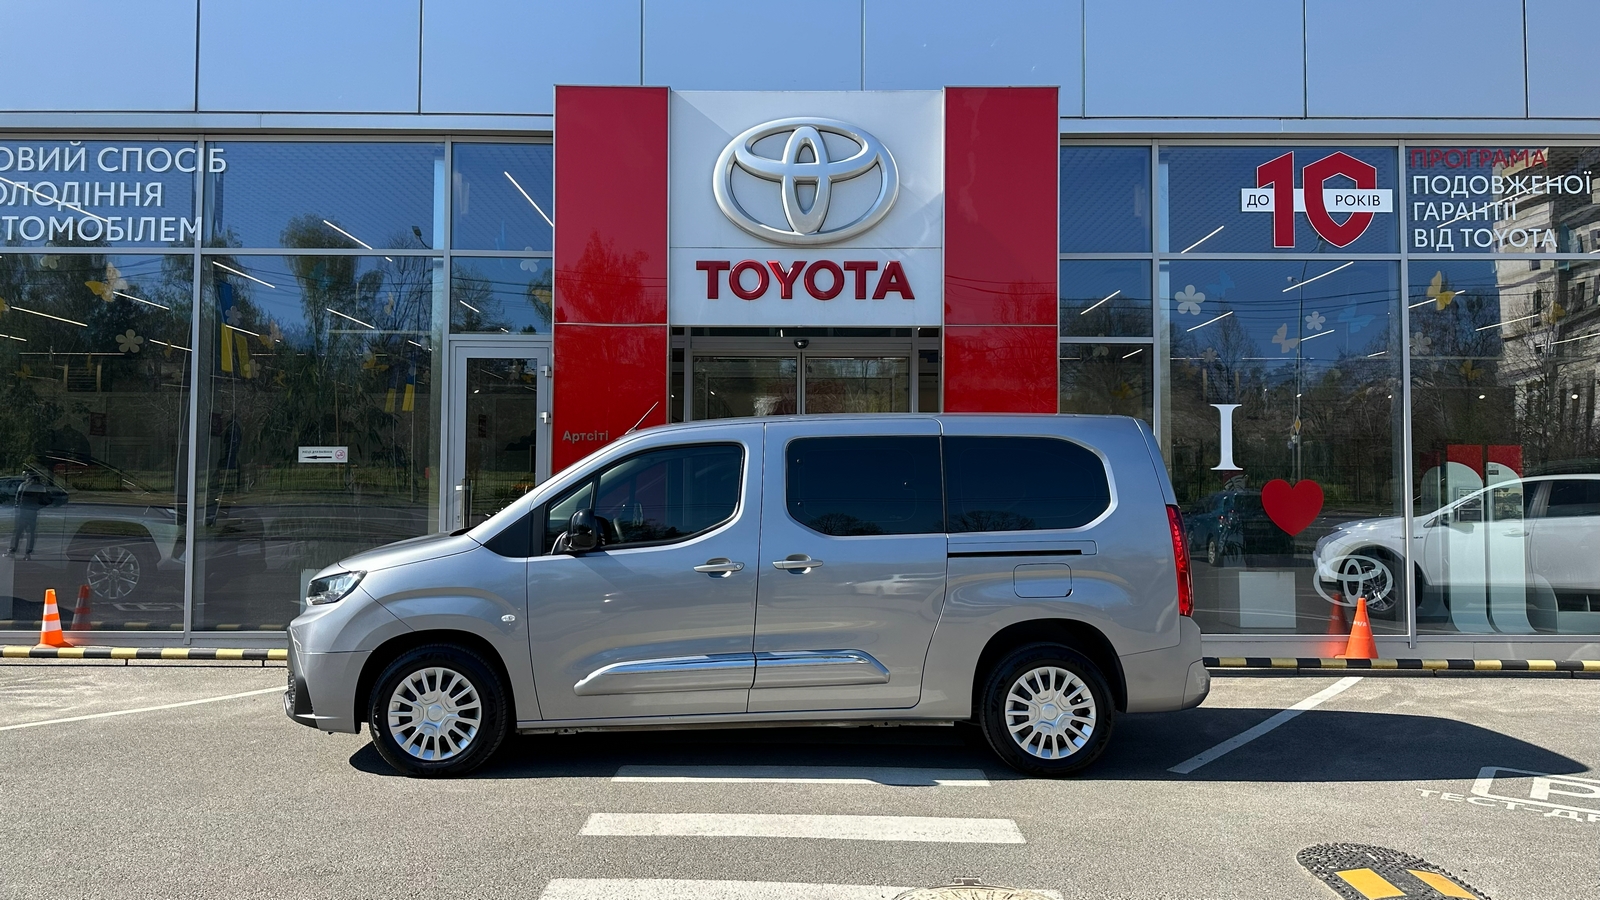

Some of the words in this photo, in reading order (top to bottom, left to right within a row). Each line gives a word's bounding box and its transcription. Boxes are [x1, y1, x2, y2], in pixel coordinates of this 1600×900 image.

[97, 147, 227, 173] СПОСІБ
[1411, 148, 1548, 168] ПРОГРАМА
[1413, 171, 1592, 199] ПОДОВЖЕНОЇ
[1246, 194, 1270, 208] ДО
[1256, 150, 1378, 248] 10
[1335, 194, 1381, 206] РОКІВ
[1414, 197, 1517, 221] ГАРАНТІЇ
[1414, 228, 1455, 252] ВІД
[1460, 228, 1558, 248] TOYOTA
[696, 259, 915, 301] TOYOTA
[562, 430, 609, 444] Артсіті
[1209, 403, 1244, 471] I
